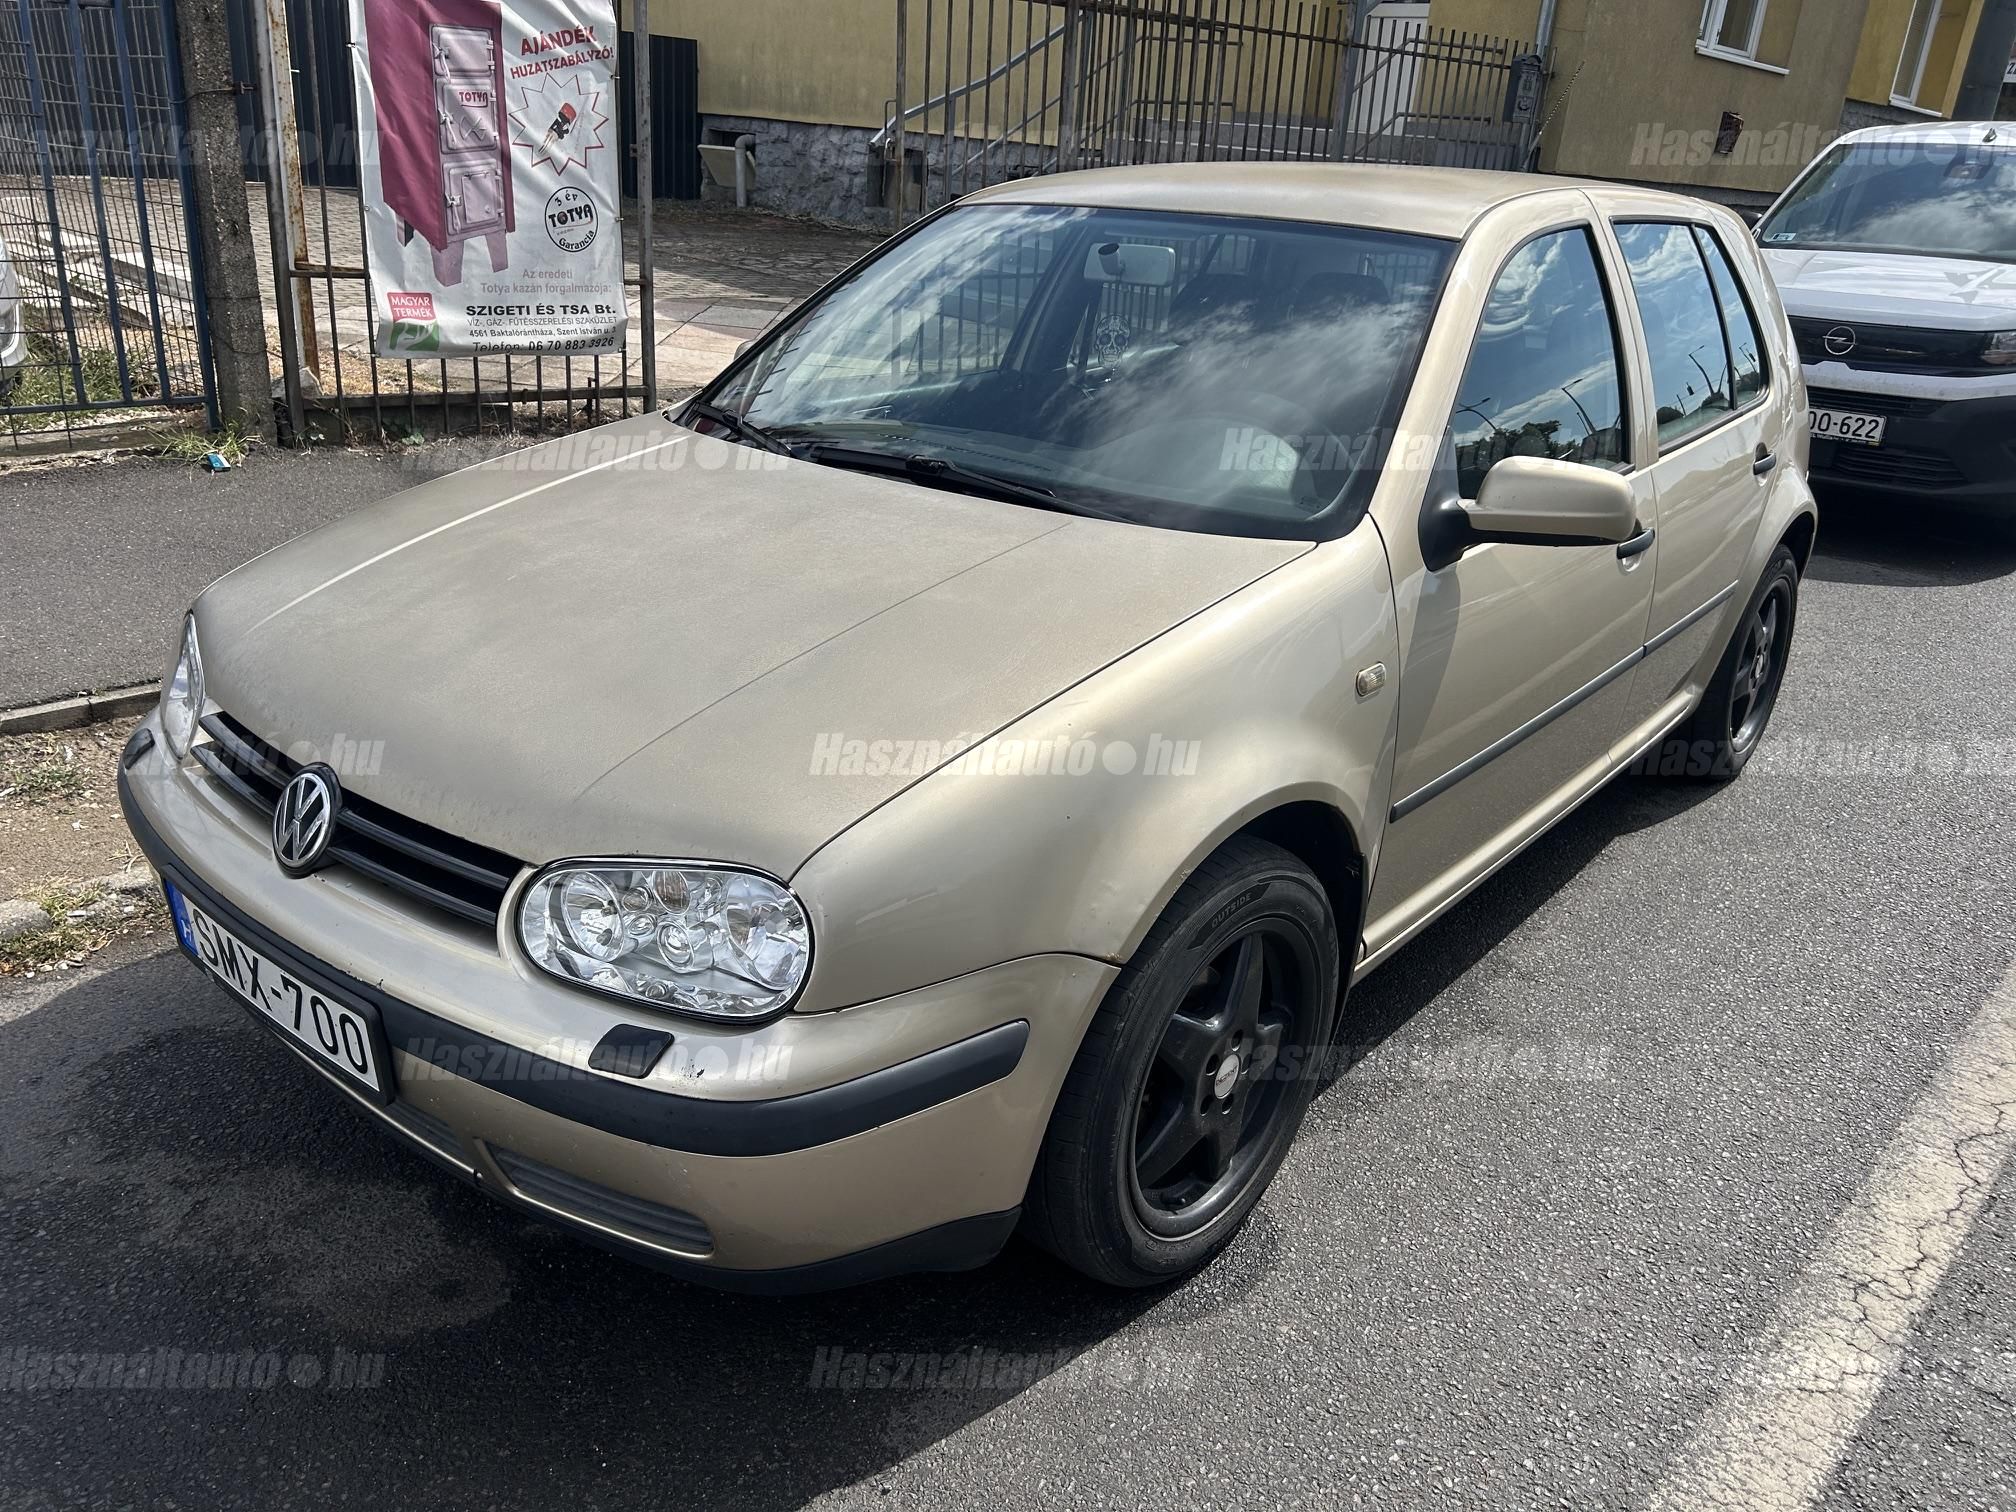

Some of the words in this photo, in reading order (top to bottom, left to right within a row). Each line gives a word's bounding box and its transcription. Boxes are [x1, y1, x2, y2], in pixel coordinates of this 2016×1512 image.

[521, 25, 597, 56] AJÁNDÉK
[510, 45, 615, 80] HUZATSZABÁLYZÓ!
[548, 203, 594, 229] TOTYA
[558, 229, 595, 250] Garancia
[522, 268, 536, 279] Az
[538, 269, 573, 279] eredeti
[480, 282, 511, 295] Totya
[513, 282, 543, 293] kazán
[545, 282, 612, 295] forgalmazója:
[390, 296, 431, 306] MAGYAR
[393, 306, 433, 318] TERMÉK
[466, 305, 531, 316] SZIGETI
[536, 302, 556, 315] ÉS
[559, 305, 590, 315] TSA
[595, 304, 617, 315] Bt.
[556, 327, 579, 336] Szent
[580, 326, 603, 335] István
[528, 340, 544, 351] 06
[547, 340, 562, 351] 70
[564, 339, 586, 350] 883
[588, 336, 615, 349] 3926
